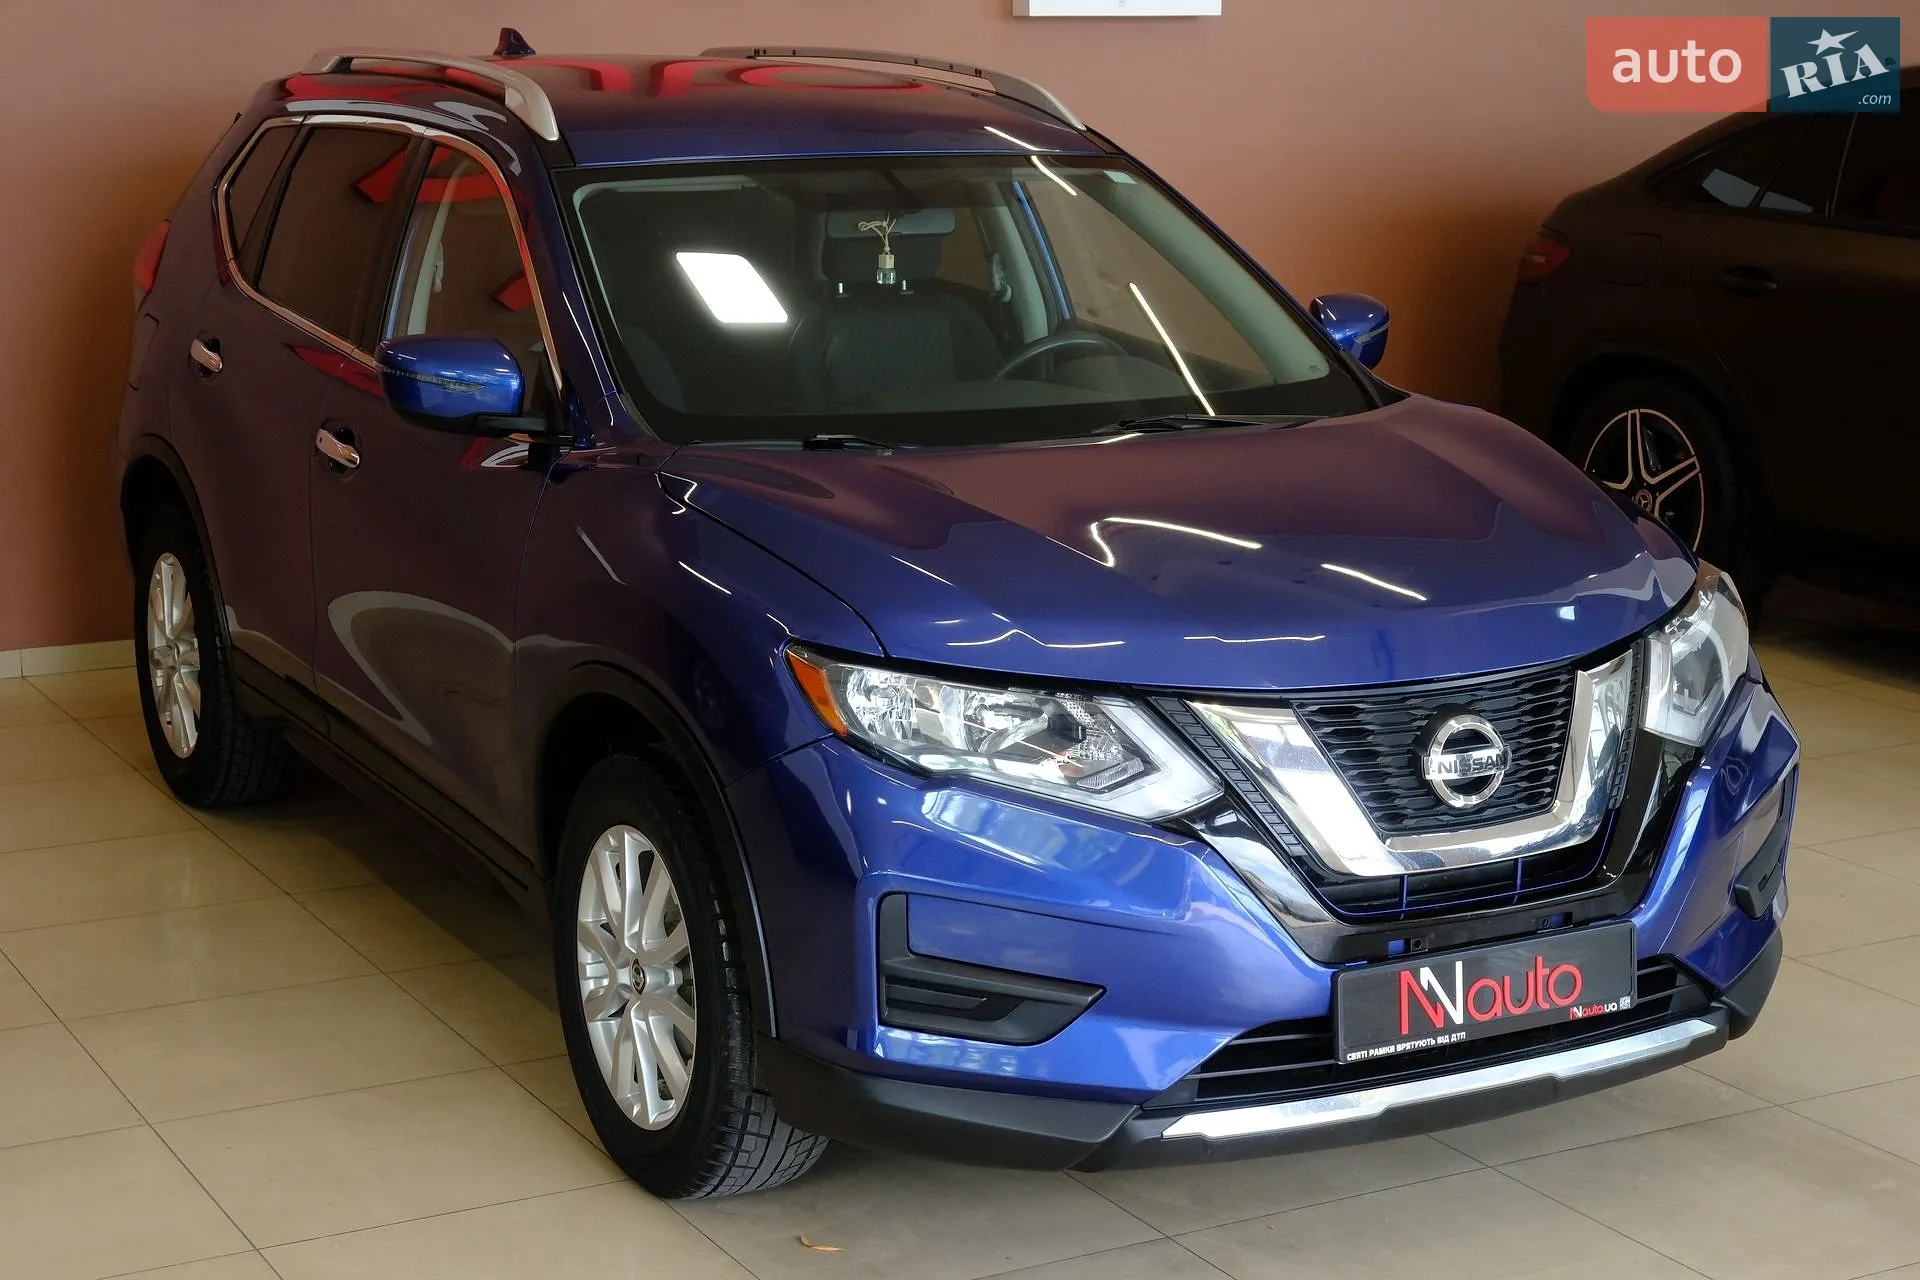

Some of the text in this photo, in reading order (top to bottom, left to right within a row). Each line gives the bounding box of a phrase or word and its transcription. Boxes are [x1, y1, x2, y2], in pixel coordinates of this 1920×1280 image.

[1437, 752, 1507, 775] NISSAN
[1346, 1031, 1466, 1061] СВЯТІ РАМКИ ВРЯТУЮТЬ ВІД ДТП
